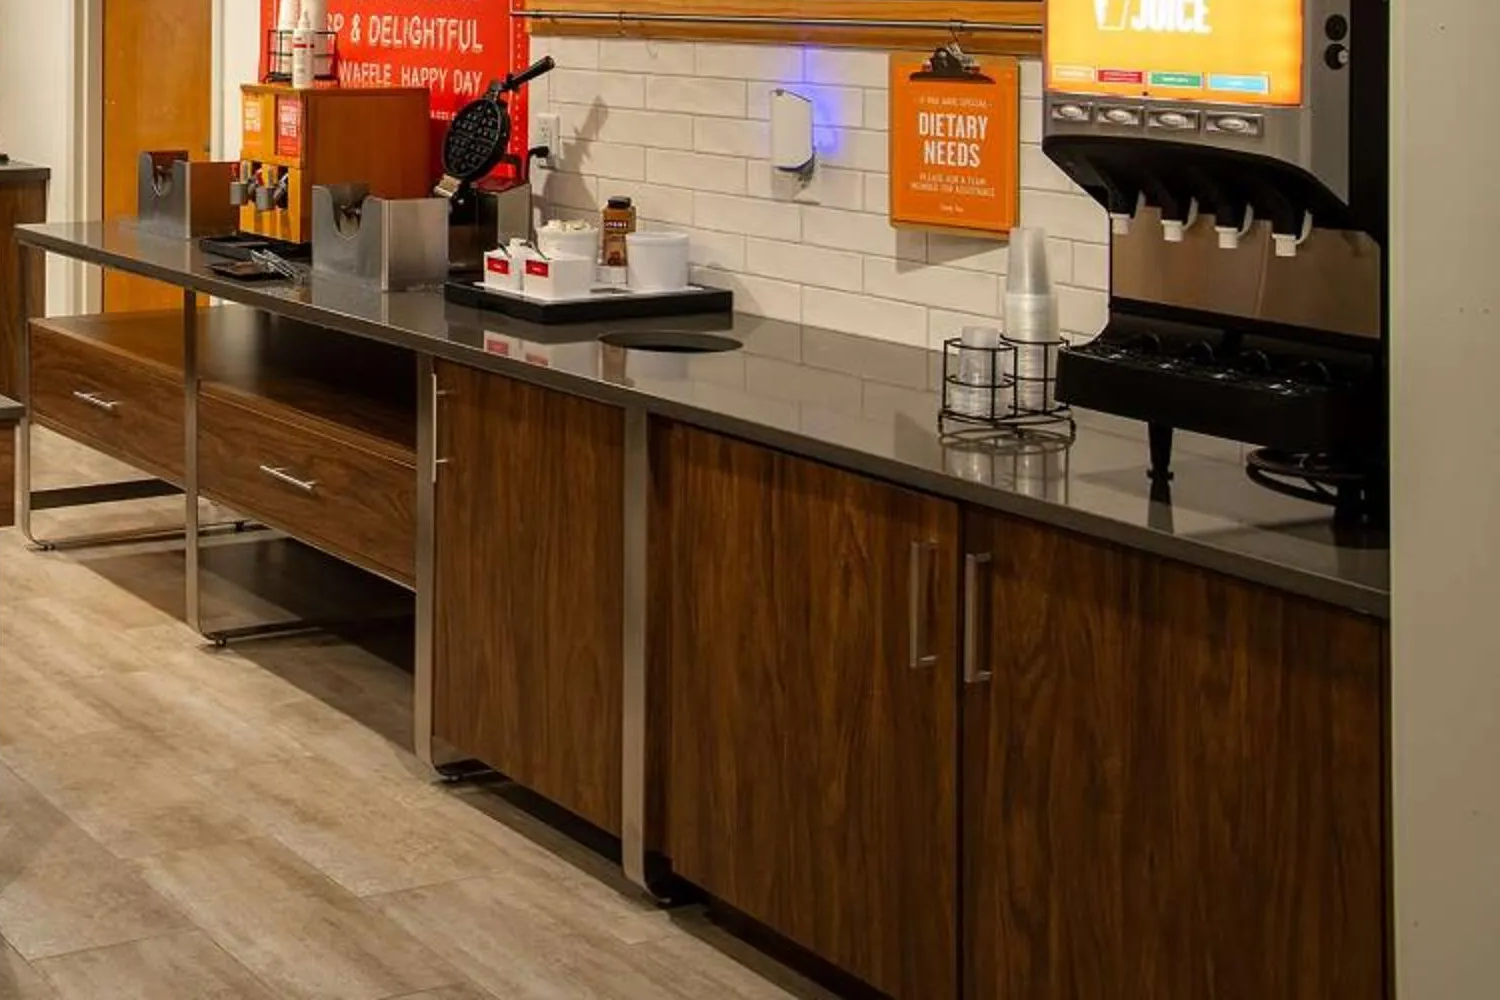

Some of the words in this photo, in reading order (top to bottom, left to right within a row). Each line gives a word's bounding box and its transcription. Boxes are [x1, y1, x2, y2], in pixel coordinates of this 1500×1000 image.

[350, 12, 361, 46] &
[368, 13, 484, 54] DELIGHTFUL
[401, 65, 448, 93] HAPPY
[453, 69, 483, 97] DAY
[918, 111, 989, 140] DIETARY
[923, 140, 981, 167] NEEDS
